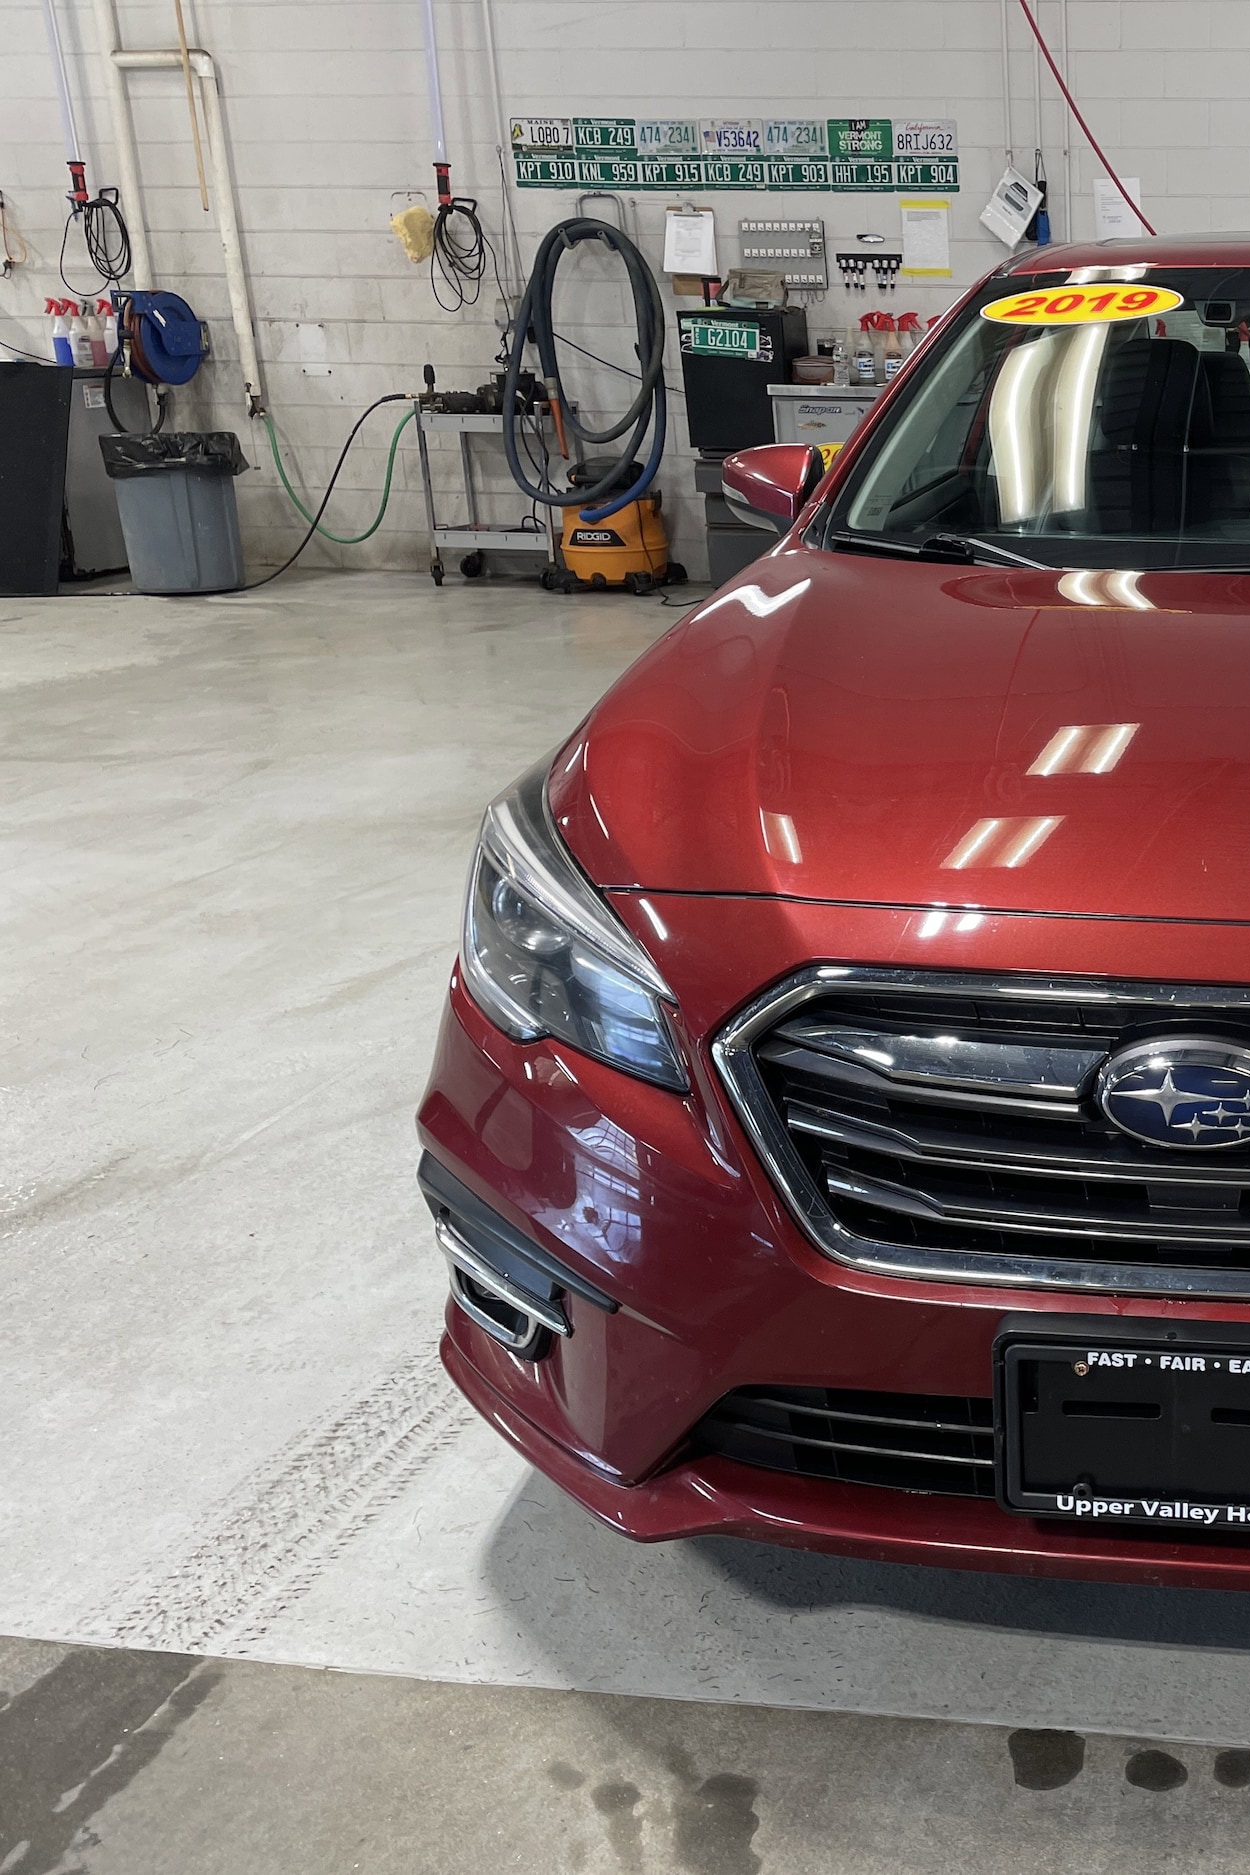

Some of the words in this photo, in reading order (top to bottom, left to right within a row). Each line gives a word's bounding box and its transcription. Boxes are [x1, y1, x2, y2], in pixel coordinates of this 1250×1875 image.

[640, 126, 661, 143] 474
[668, 126, 695, 143] 2341
[856, 121, 866, 130] AM
[562, 127, 569, 144] 7
[577, 127, 601, 145] KCB
[608, 128, 631, 145] 249
[715, 130, 760, 148] V53642
[767, 126, 788, 144] 474
[796, 126, 823, 144] 2341
[838, 131, 882, 140] VERMONT
[897, 133, 953, 150] 8RIJ632
[839, 140, 883, 151] STRONG
[519, 162, 541, 179] KPT
[549, 162, 572, 180] 910
[581, 163, 605, 181] KNL
[611, 163, 635, 181] 959
[644, 164, 667, 182] KPT
[675, 164, 699, 182] 915
[707, 164, 731, 182] KCB
[738, 164, 761, 182] 249
[770, 165, 794, 182] KPT
[801, 165, 825, 182] 903
[835, 165, 858, 183] HHT
[866, 165, 889, 183] 195
[899, 165, 923, 183] KPT
[930, 165, 954, 183] 904
[1000, 291, 1159, 318] 2019
[710, 319, 739, 328] Vermont
[707, 328, 747, 349] G2104
[576, 531, 611, 541] RIDGID
[1087, 1352, 1138, 1368] FAST
[1160, 1355, 1206, 1372] FAIR
[1056, 1495, 1135, 1517] Upper
[1140, 1500, 1219, 1524] Valley
